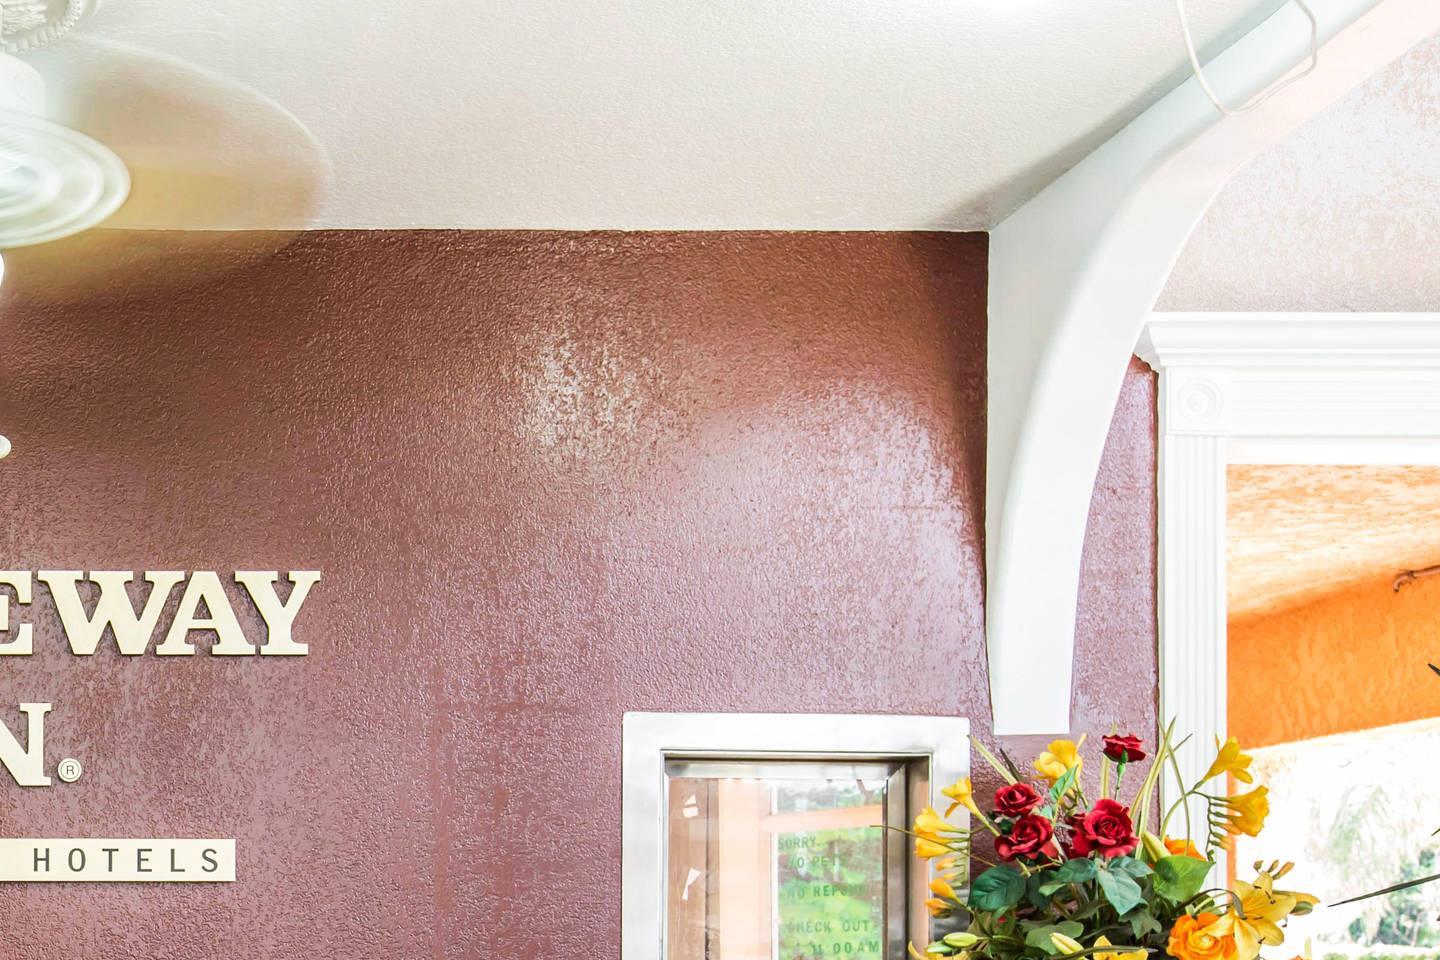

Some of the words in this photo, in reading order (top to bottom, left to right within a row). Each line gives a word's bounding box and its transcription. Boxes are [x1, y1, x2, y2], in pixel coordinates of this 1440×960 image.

[33, 847, 219, 873] HOTELS
[842, 919, 870, 932] OUT
[857, 940, 879, 953] AM
